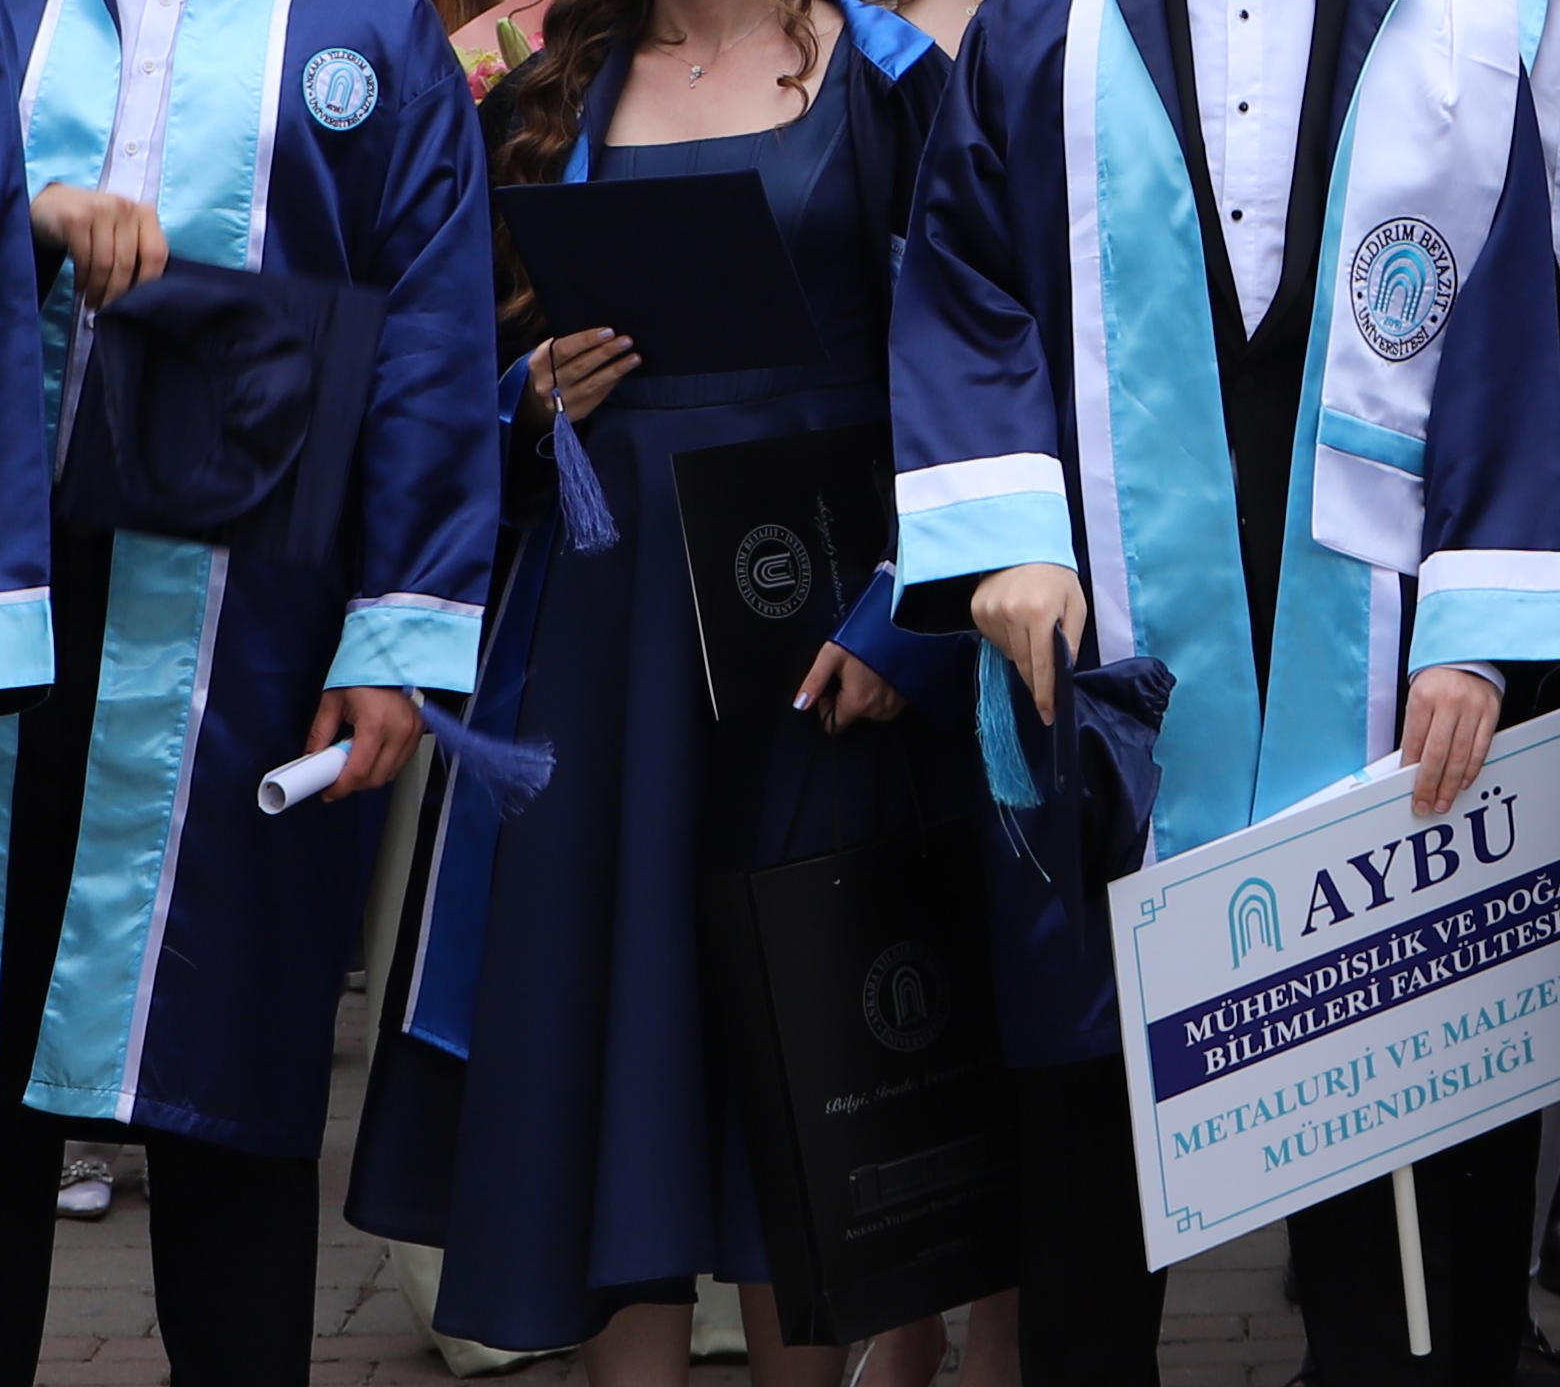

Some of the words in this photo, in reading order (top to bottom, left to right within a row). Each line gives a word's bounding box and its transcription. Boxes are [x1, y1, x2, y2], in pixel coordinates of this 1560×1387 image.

[1355, 224, 1417, 283] YILDIRIM
[1419, 230, 1453, 312] BEYAZIT
[1301, 785, 1518, 937] AYBÜ
[1184, 930, 1428, 1047] MÜHENDİSLİK
[1432, 910, 1477, 944] VE
[1203, 977, 1383, 1076] BİLİMLERİ
[1172, 1046, 1377, 1160] METALURJİ
[1385, 1029, 1433, 1070] VE
[1262, 1030, 1536, 1173] MÜHENDİSLİĞİ
